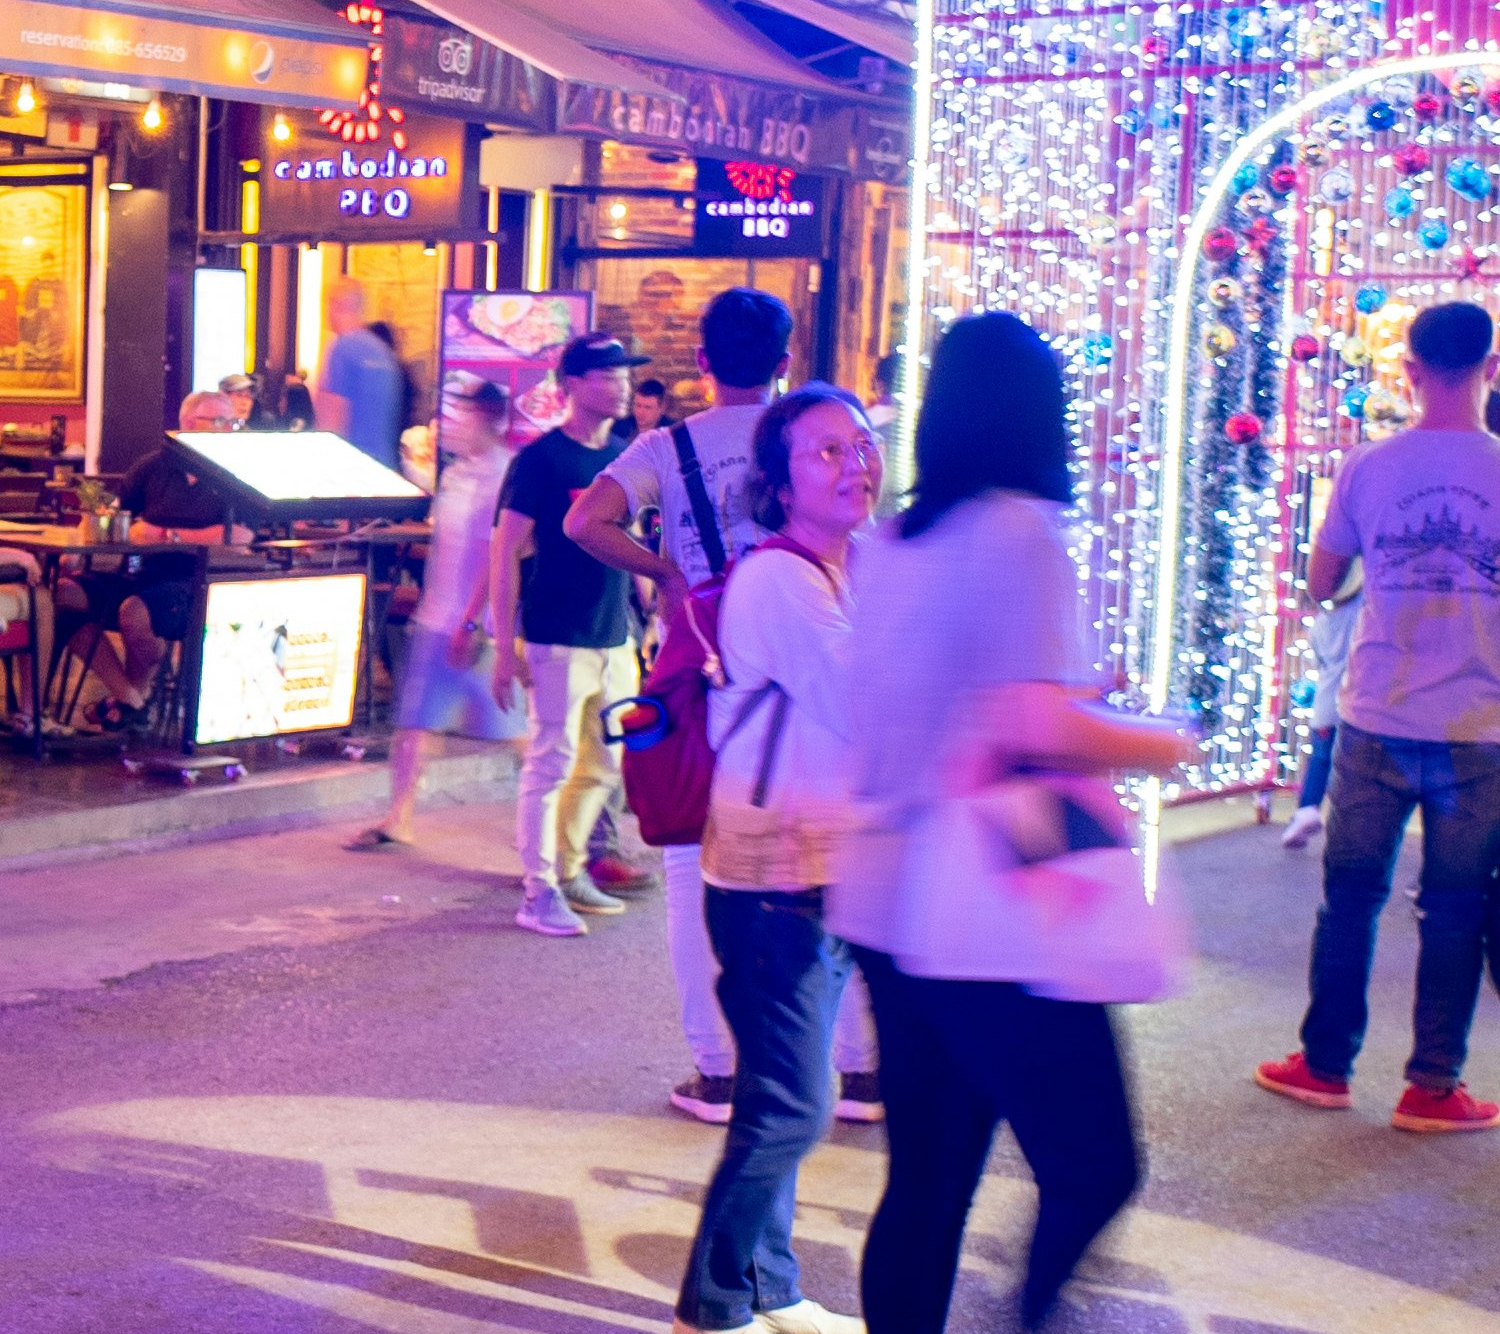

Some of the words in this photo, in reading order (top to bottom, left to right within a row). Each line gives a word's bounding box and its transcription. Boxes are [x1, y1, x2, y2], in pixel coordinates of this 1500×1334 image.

[418, 77, 485, 104] tripadvisor
[612, 104, 750, 150] cambodian
[759, 118, 811, 164] BBQ
[275, 149, 447, 179] cambodian
[706, 198, 814, 216] cambodian
[742, 217, 790, 238] BBQ
